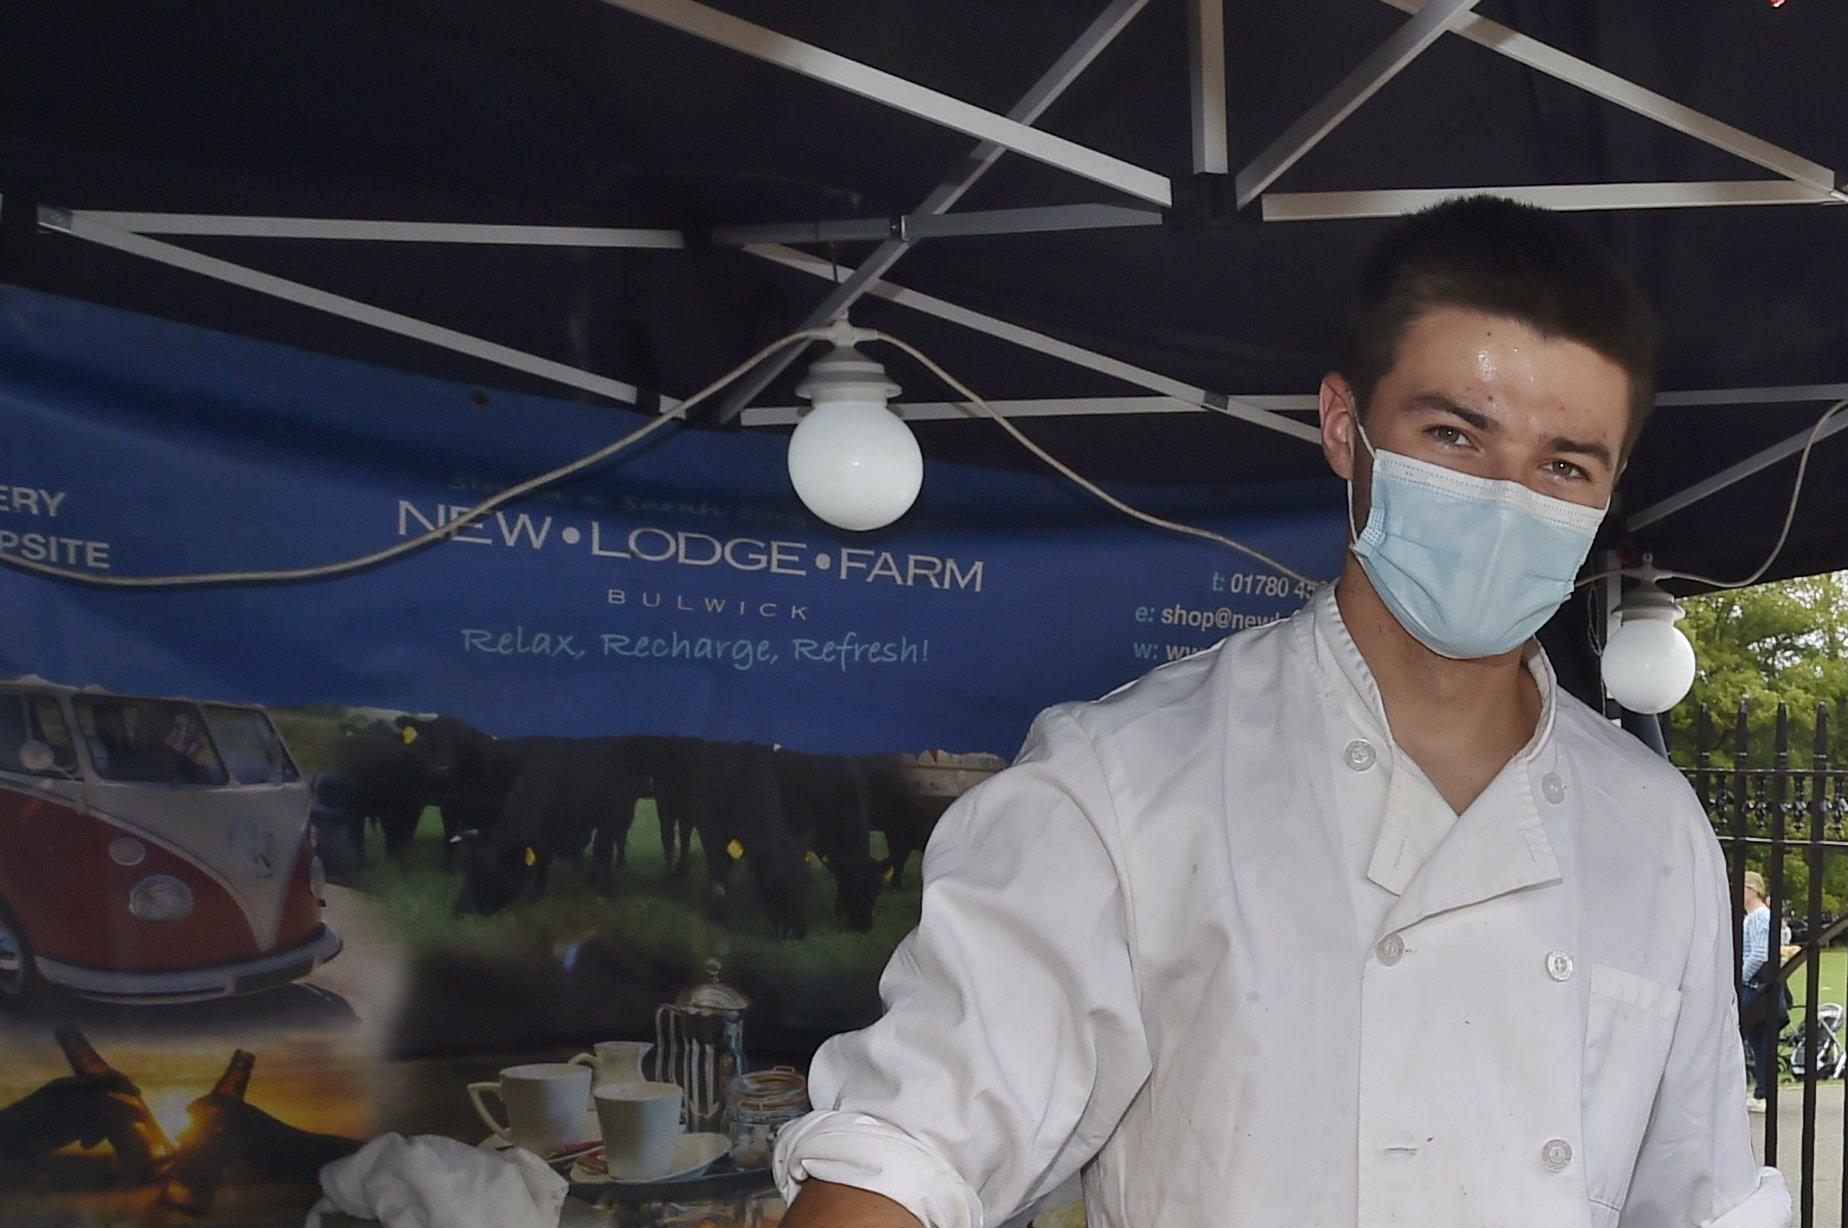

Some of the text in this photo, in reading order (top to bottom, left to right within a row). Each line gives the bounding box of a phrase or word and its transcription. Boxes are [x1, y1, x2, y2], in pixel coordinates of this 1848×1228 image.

[0, 485, 66, 517] ERY
[0, 529, 110, 569] PSITE
[397, 500, 985, 592] NEW LODGE FARM
[1230, 573, 1289, 598] 01780
[608, 589, 807, 621] BULWICK
[461, 626, 928, 672] Relax, Recharge, Refresh!
